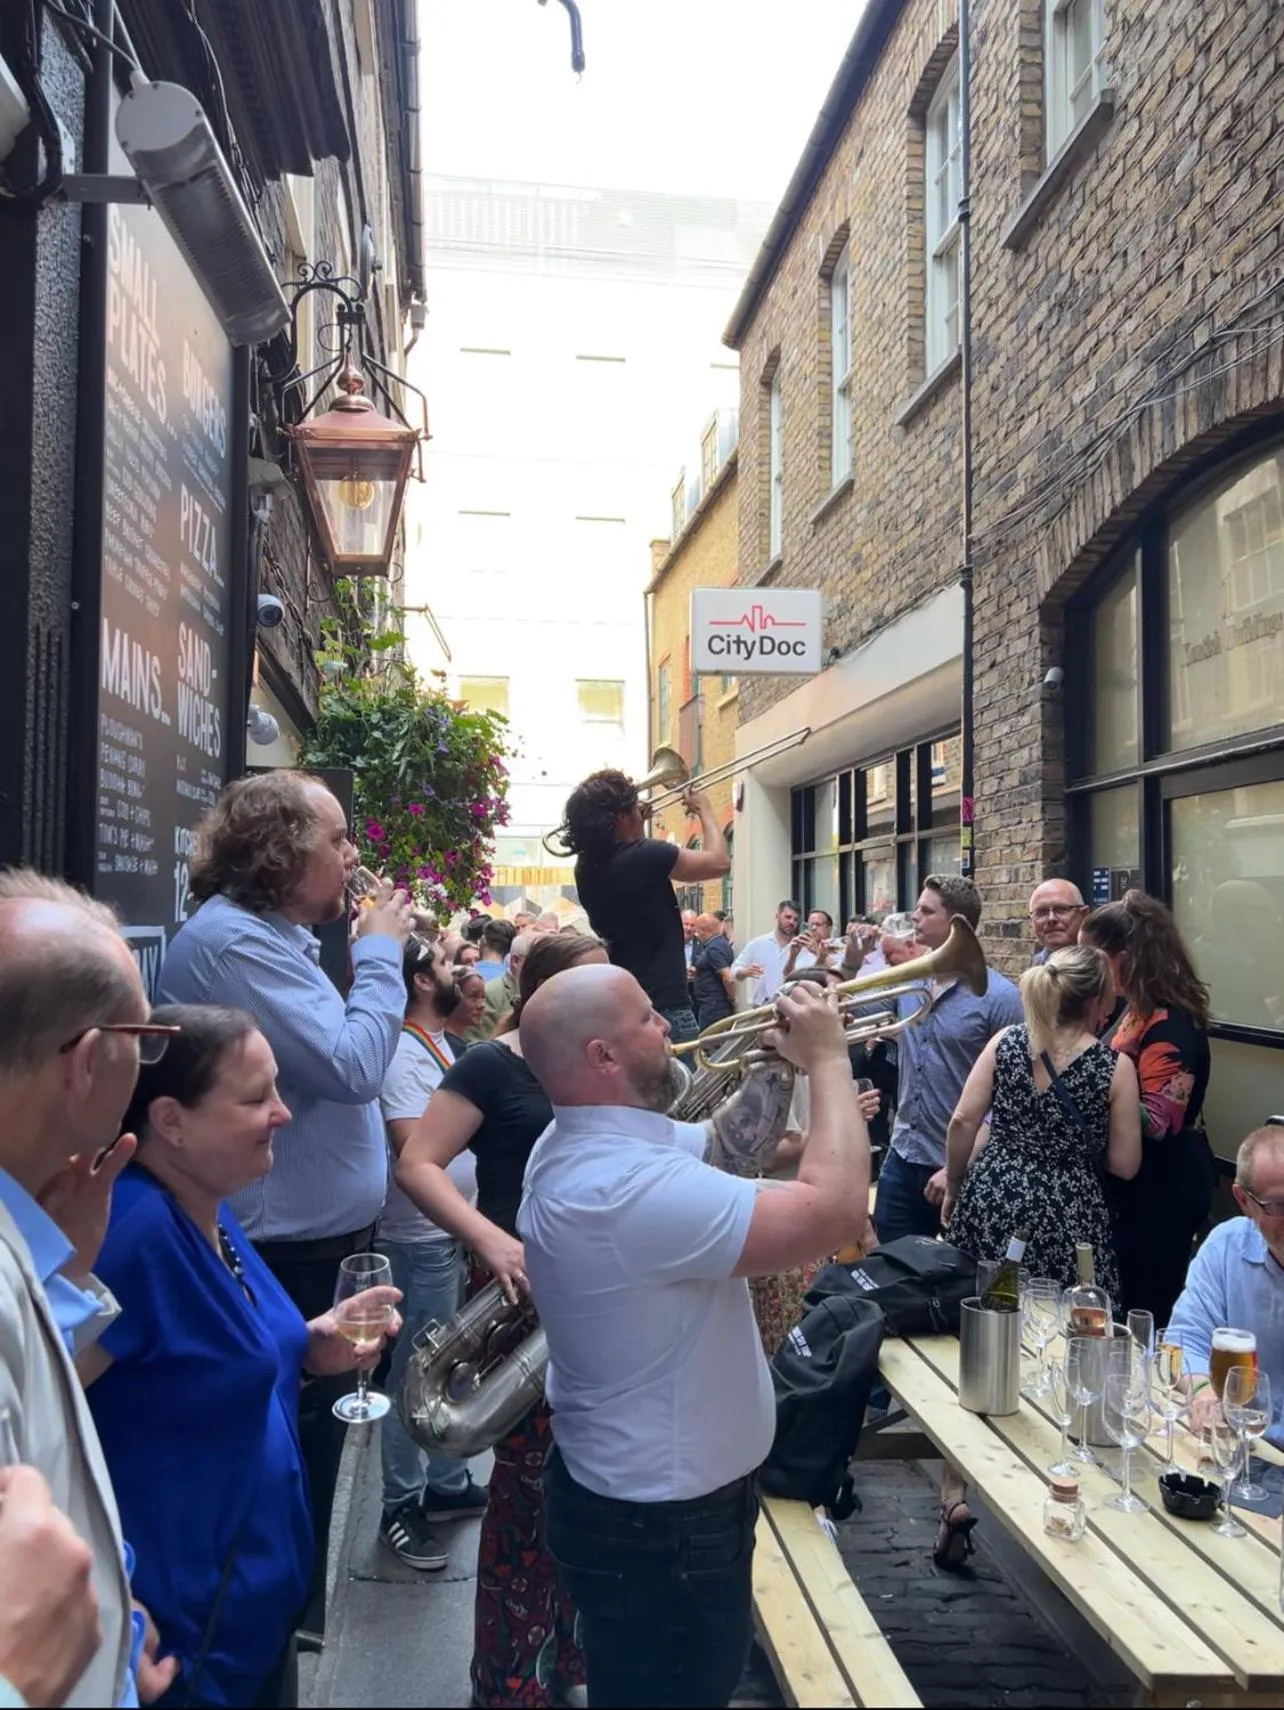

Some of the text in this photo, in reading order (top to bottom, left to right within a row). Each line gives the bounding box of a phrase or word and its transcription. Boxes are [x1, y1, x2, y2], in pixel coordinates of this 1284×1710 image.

[108, 203, 160, 349] SMALL
[108, 275, 167, 424] PLATES
[183, 338, 227, 459] BURGERS
[179, 482, 219, 577] PIZZA
[177, 621, 218, 697] SAND-
[707, 634, 806, 661] CityDoc
[176, 680, 221, 758] WICHES
